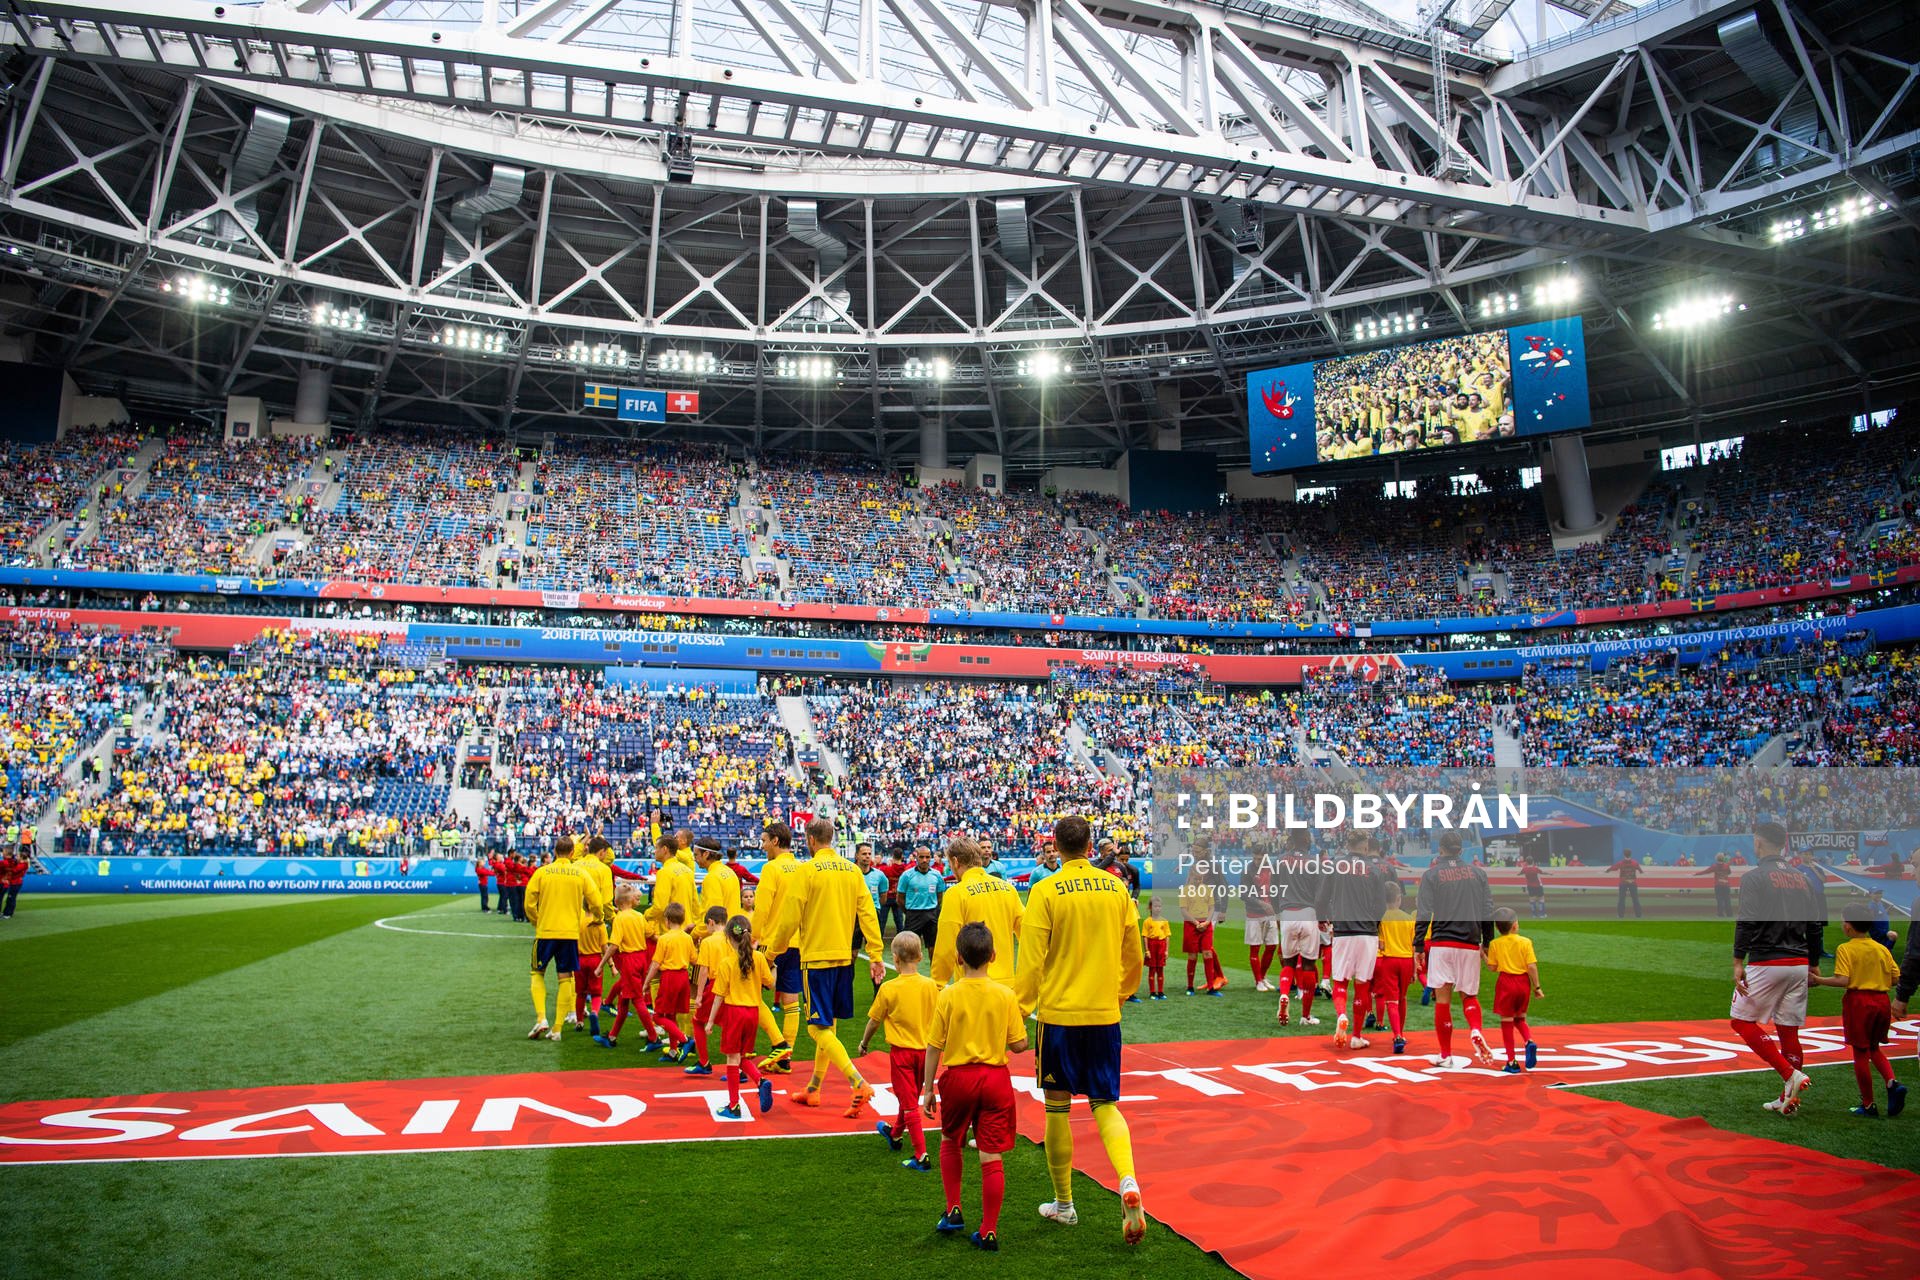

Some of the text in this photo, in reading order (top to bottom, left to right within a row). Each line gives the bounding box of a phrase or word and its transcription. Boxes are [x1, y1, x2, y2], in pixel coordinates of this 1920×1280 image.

[625, 399, 658, 413] FIFA
[613, 597, 666, 609] #worldcup
[9, 608, 71, 621] #worldcup
[541, 629, 726, 646] 2018 FIFA WORLD CUP RUSSIA
[1516, 645, 1592, 658] ЧЕМПИОНАТ
[1594, 642, 1631, 653] МИРА
[1633, 638, 1652, 650] ПО
[1654, 633, 1714, 647] ФУТБОЛУ
[1717, 629, 1745, 641] FIFA
[1747, 624, 1777, 638] 2018
[1791, 616, 1848, 633] РОССИИ
[1082, 650, 1189, 663] SAINT PETERSBURG
[1791, 834, 1856, 848] HARZBURG
[1438, 865, 1475, 881] SUISSE
[141, 879, 211, 889] ЧЕМПИОНАТ
[213, 879, 247, 889] МИРА
[249, 879, 265, 889] ПО
[267, 879, 319, 889] ФУТБОЛУ
[322, 879, 345, 889] FIFA
[347, 879, 372, 889] 2018
[1055, 878, 1118, 896] SVERIGE
[0, 1088, 787, 1145] SAINT
